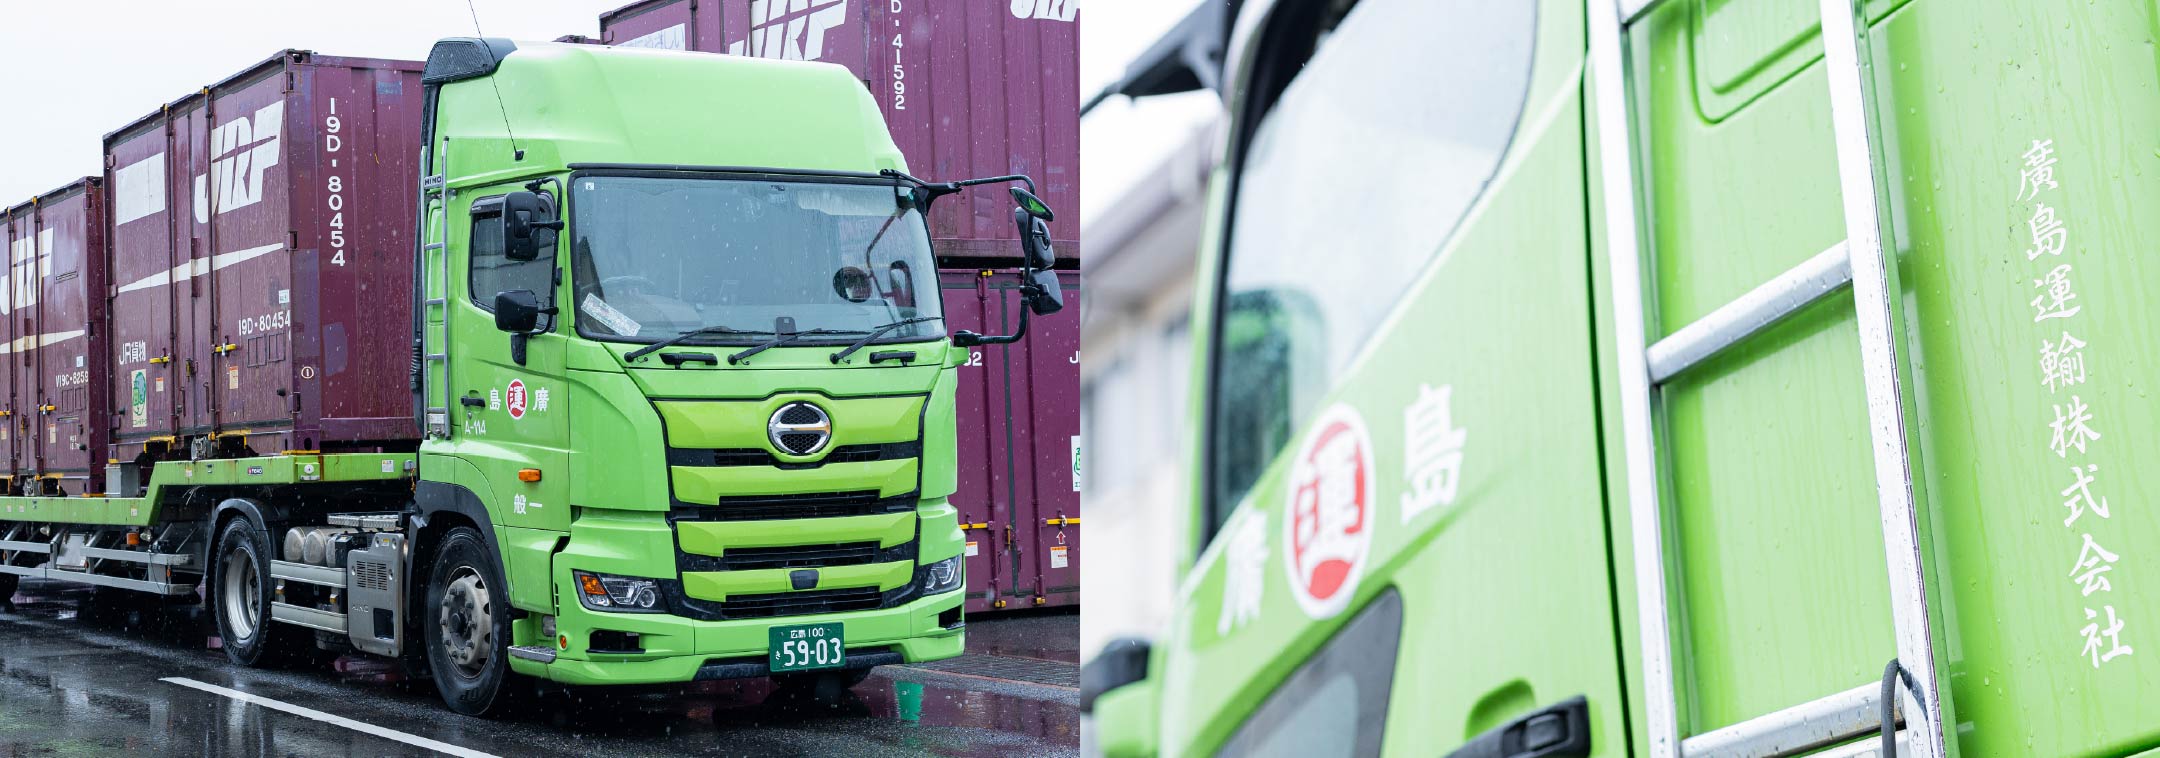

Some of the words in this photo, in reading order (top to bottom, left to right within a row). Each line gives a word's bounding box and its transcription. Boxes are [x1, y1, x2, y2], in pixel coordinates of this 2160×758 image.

[194, 100, 284, 224] JRF
[424, 176, 442, 186] HINO
[0, 227, 54, 315] JRF
[118, 339, 146, 365] JR貨物
[2015, 137, 2134, 669] 廣島運輸株式会社
[464, 419, 487, 436] A-114
[1401, 383, 1467, 525] 島
[790, 629, 806, 639] 広島
[808, 627, 824, 638] 100
[783, 637, 842, 667] 59-03
